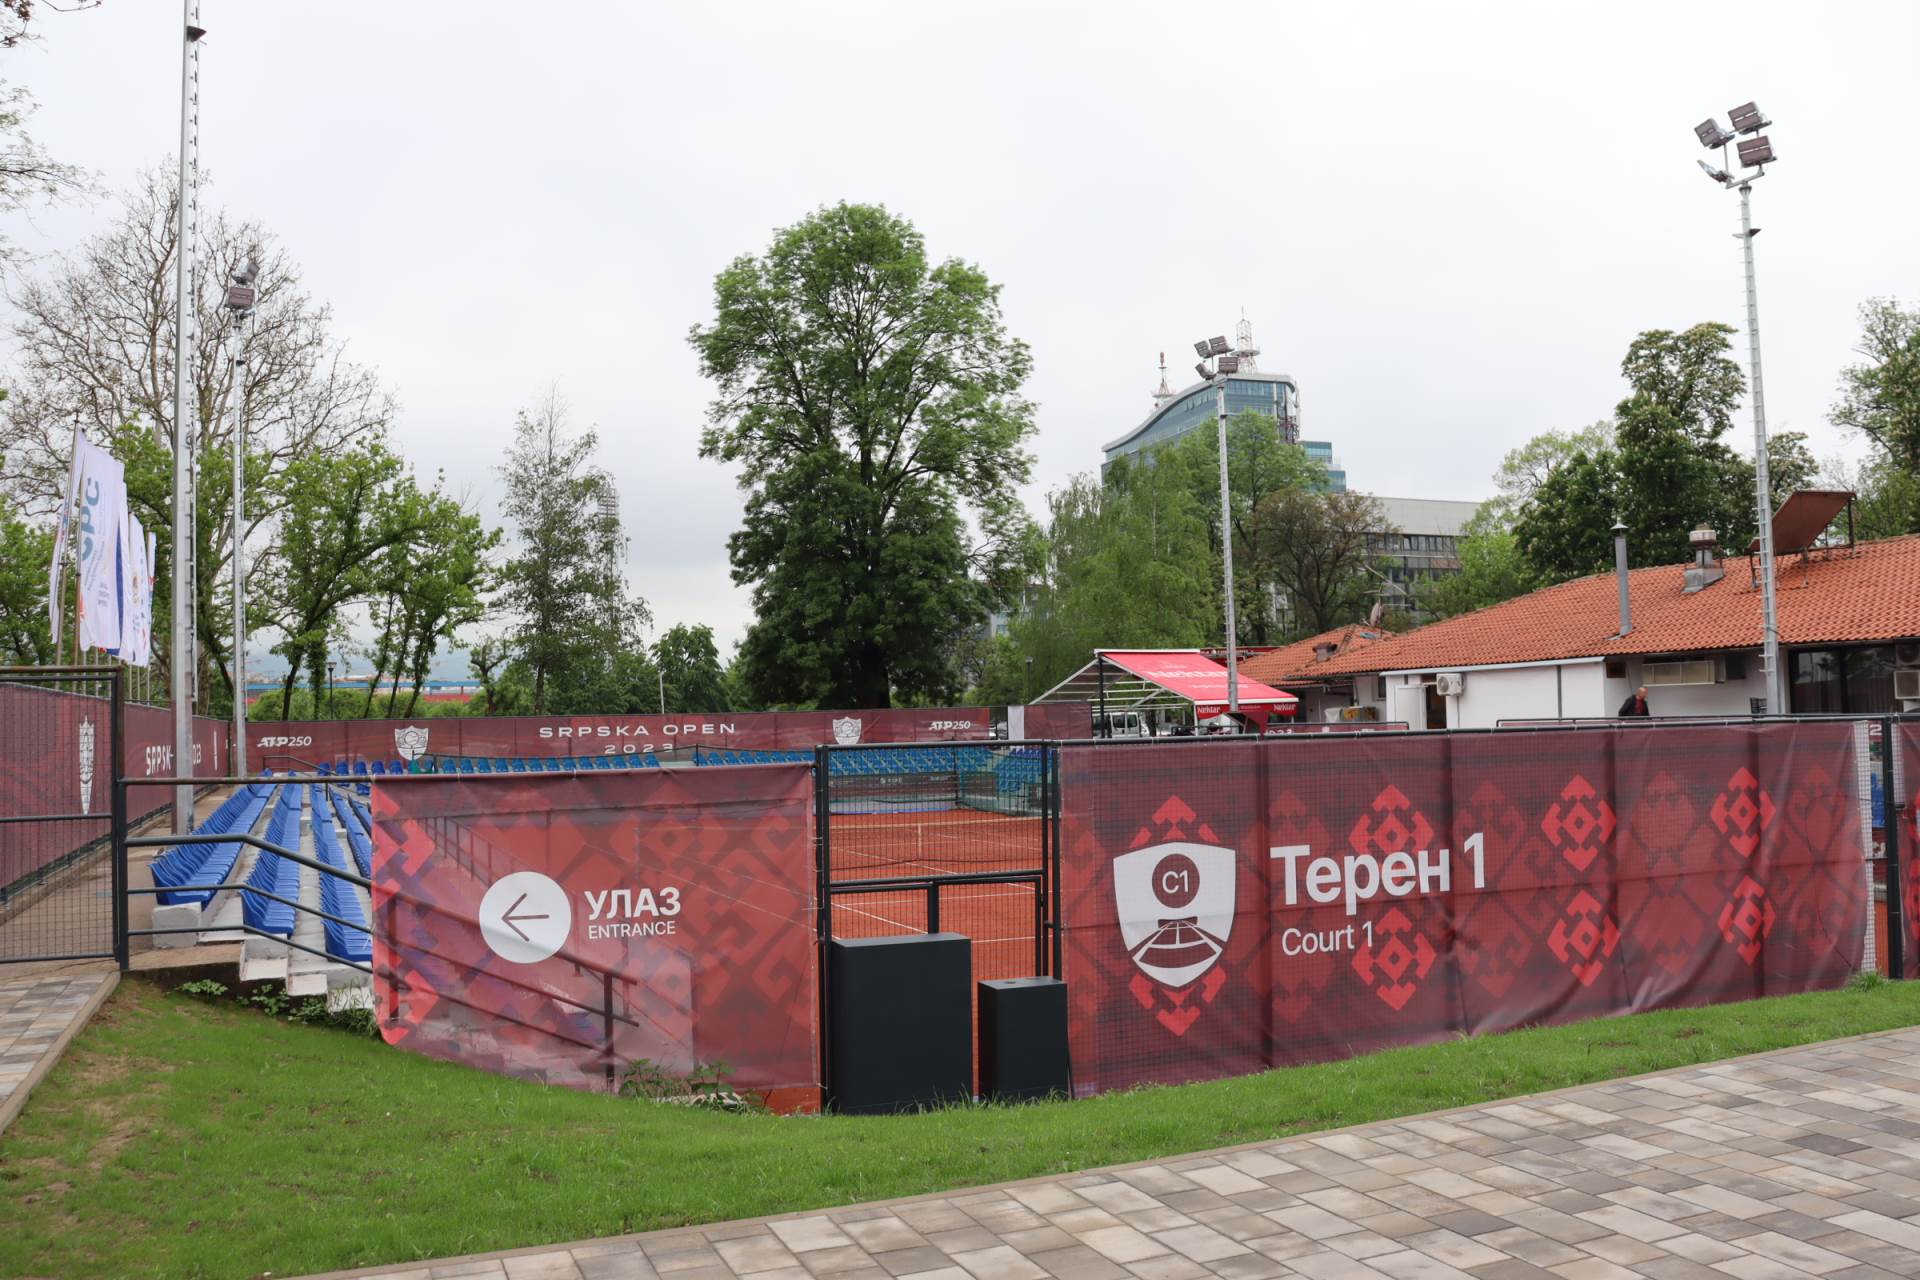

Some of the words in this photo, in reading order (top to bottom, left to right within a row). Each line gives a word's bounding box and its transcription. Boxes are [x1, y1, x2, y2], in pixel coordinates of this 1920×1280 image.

[1197, 705, 1221, 713] Nektar
[1273, 704, 1296, 712] Nektar
[539, 725, 649, 737] SRPSKA
[663, 723, 735, 735] OPEN
[605, 743, 673, 754] 2023
[1162, 870, 1189, 894] C1
[1270, 844, 1450, 916] Терен
[1463, 832, 1485, 889] 1
[584, 886, 681, 920] УЛАЗ
[588, 921, 676, 939] ENTRANCE
[1282, 924, 1355, 956] Court
[1362, 920, 1373, 947] 1
